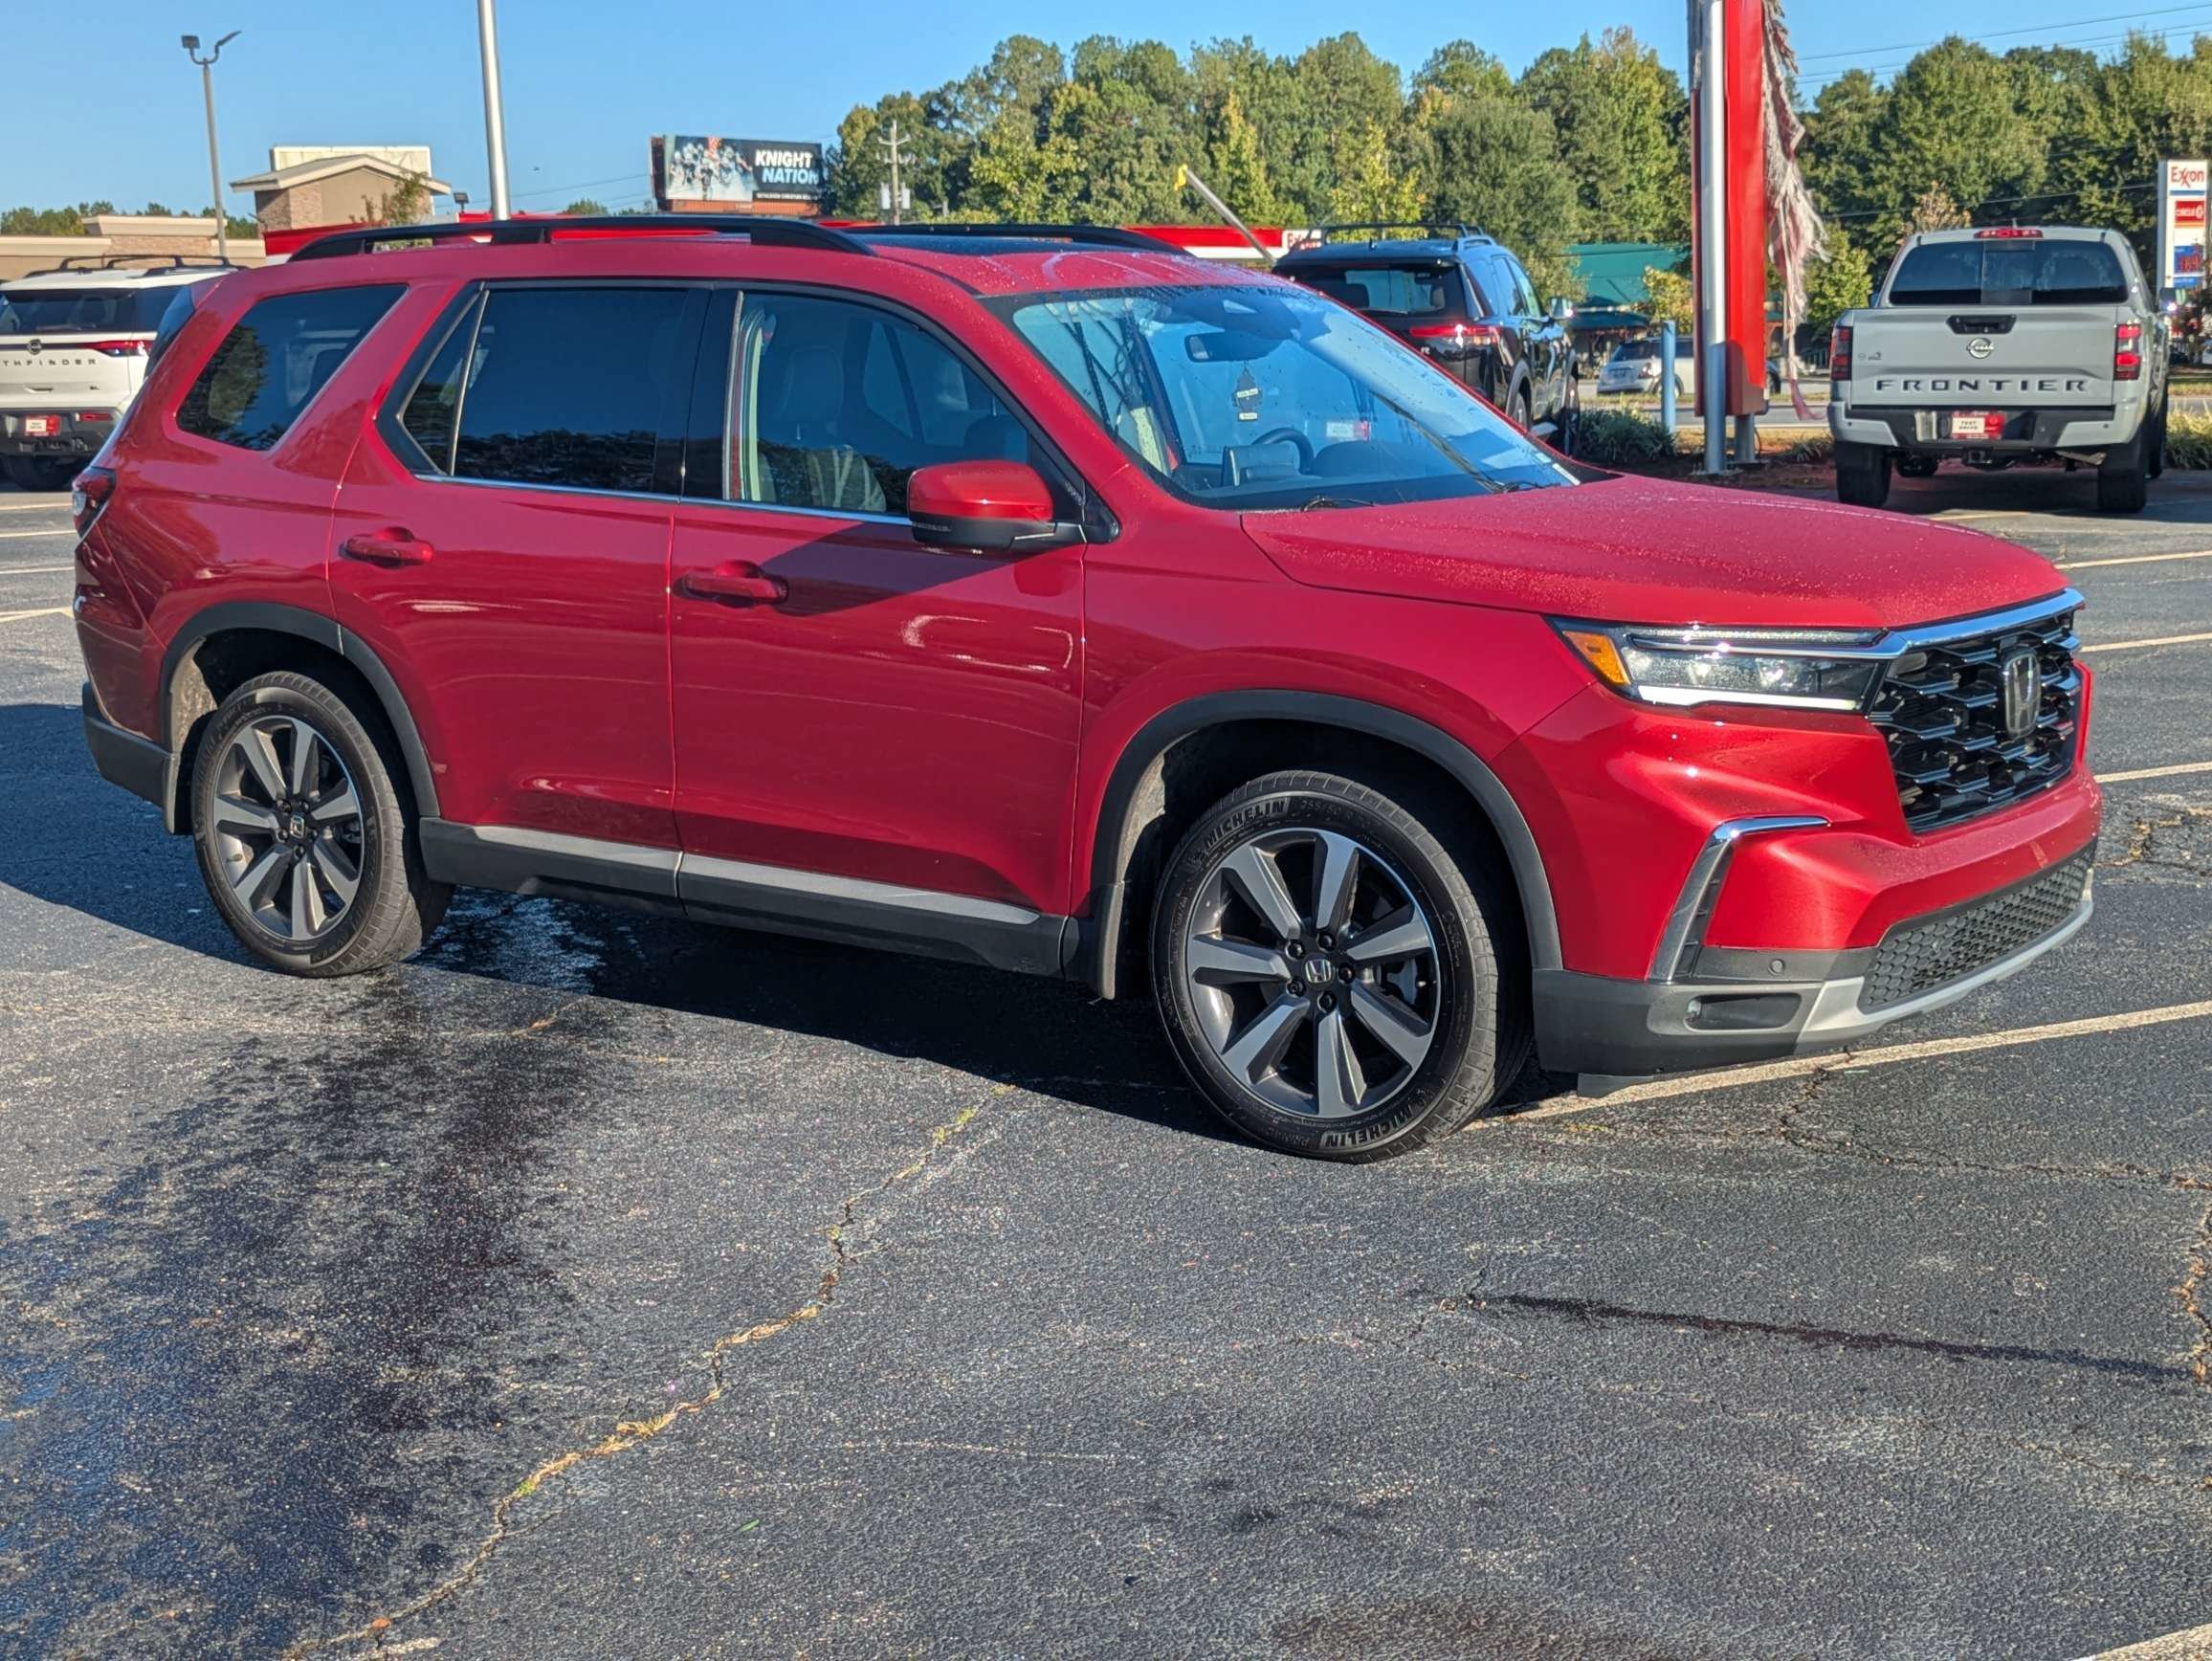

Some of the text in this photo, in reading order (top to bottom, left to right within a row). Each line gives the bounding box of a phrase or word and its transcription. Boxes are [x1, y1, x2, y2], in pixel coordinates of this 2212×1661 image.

[754, 149, 813, 168] KNIGHT
[762, 167, 819, 185] NATION
[2170, 166, 2204, 188] Exxon
[1875, 380, 2087, 391] FRONTIER
[1206, 798, 1287, 850] MICHELIN
[1324, 1104, 1413, 1147] MICHELIN
